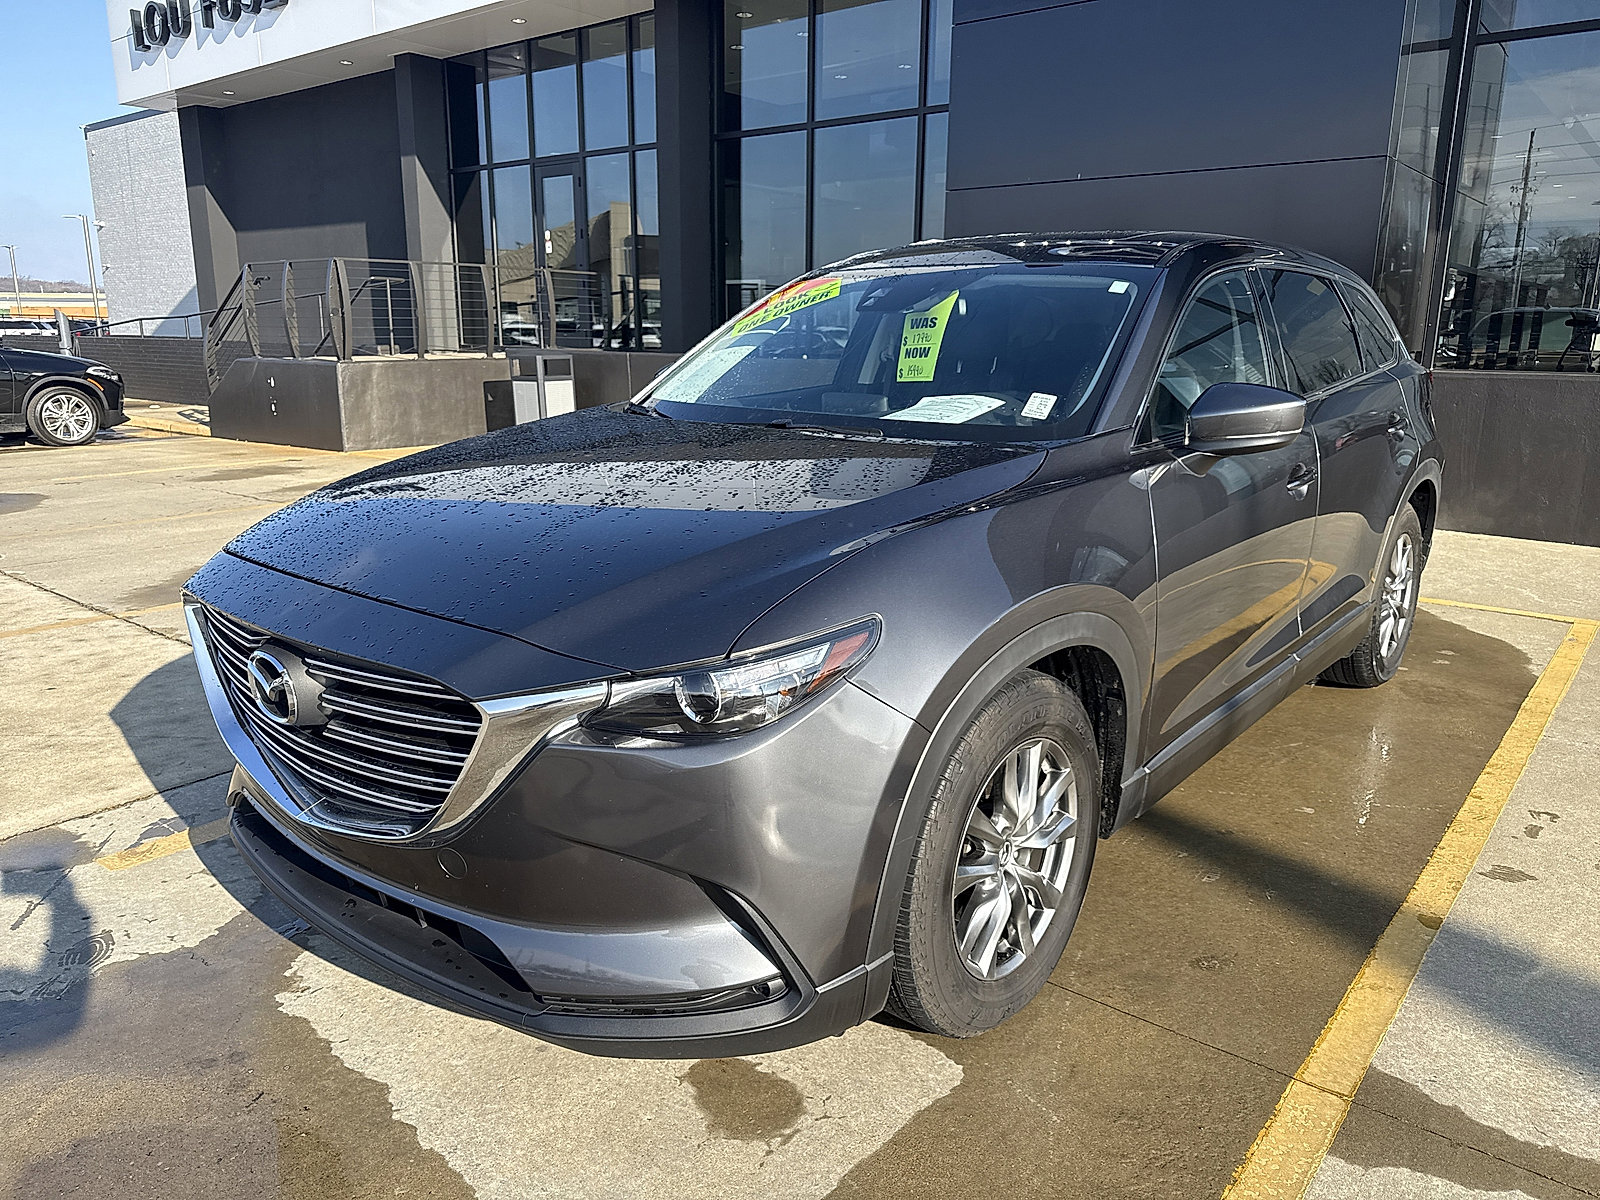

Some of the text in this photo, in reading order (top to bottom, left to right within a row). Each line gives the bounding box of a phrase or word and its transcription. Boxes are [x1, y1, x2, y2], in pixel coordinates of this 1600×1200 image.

[130, 0, 289, 52] LOU FU
[763, 290, 811, 313] LOOK
[737, 314, 771, 334] ONE
[910, 317, 938, 329] WAS
[904, 347, 931, 359] NOW
